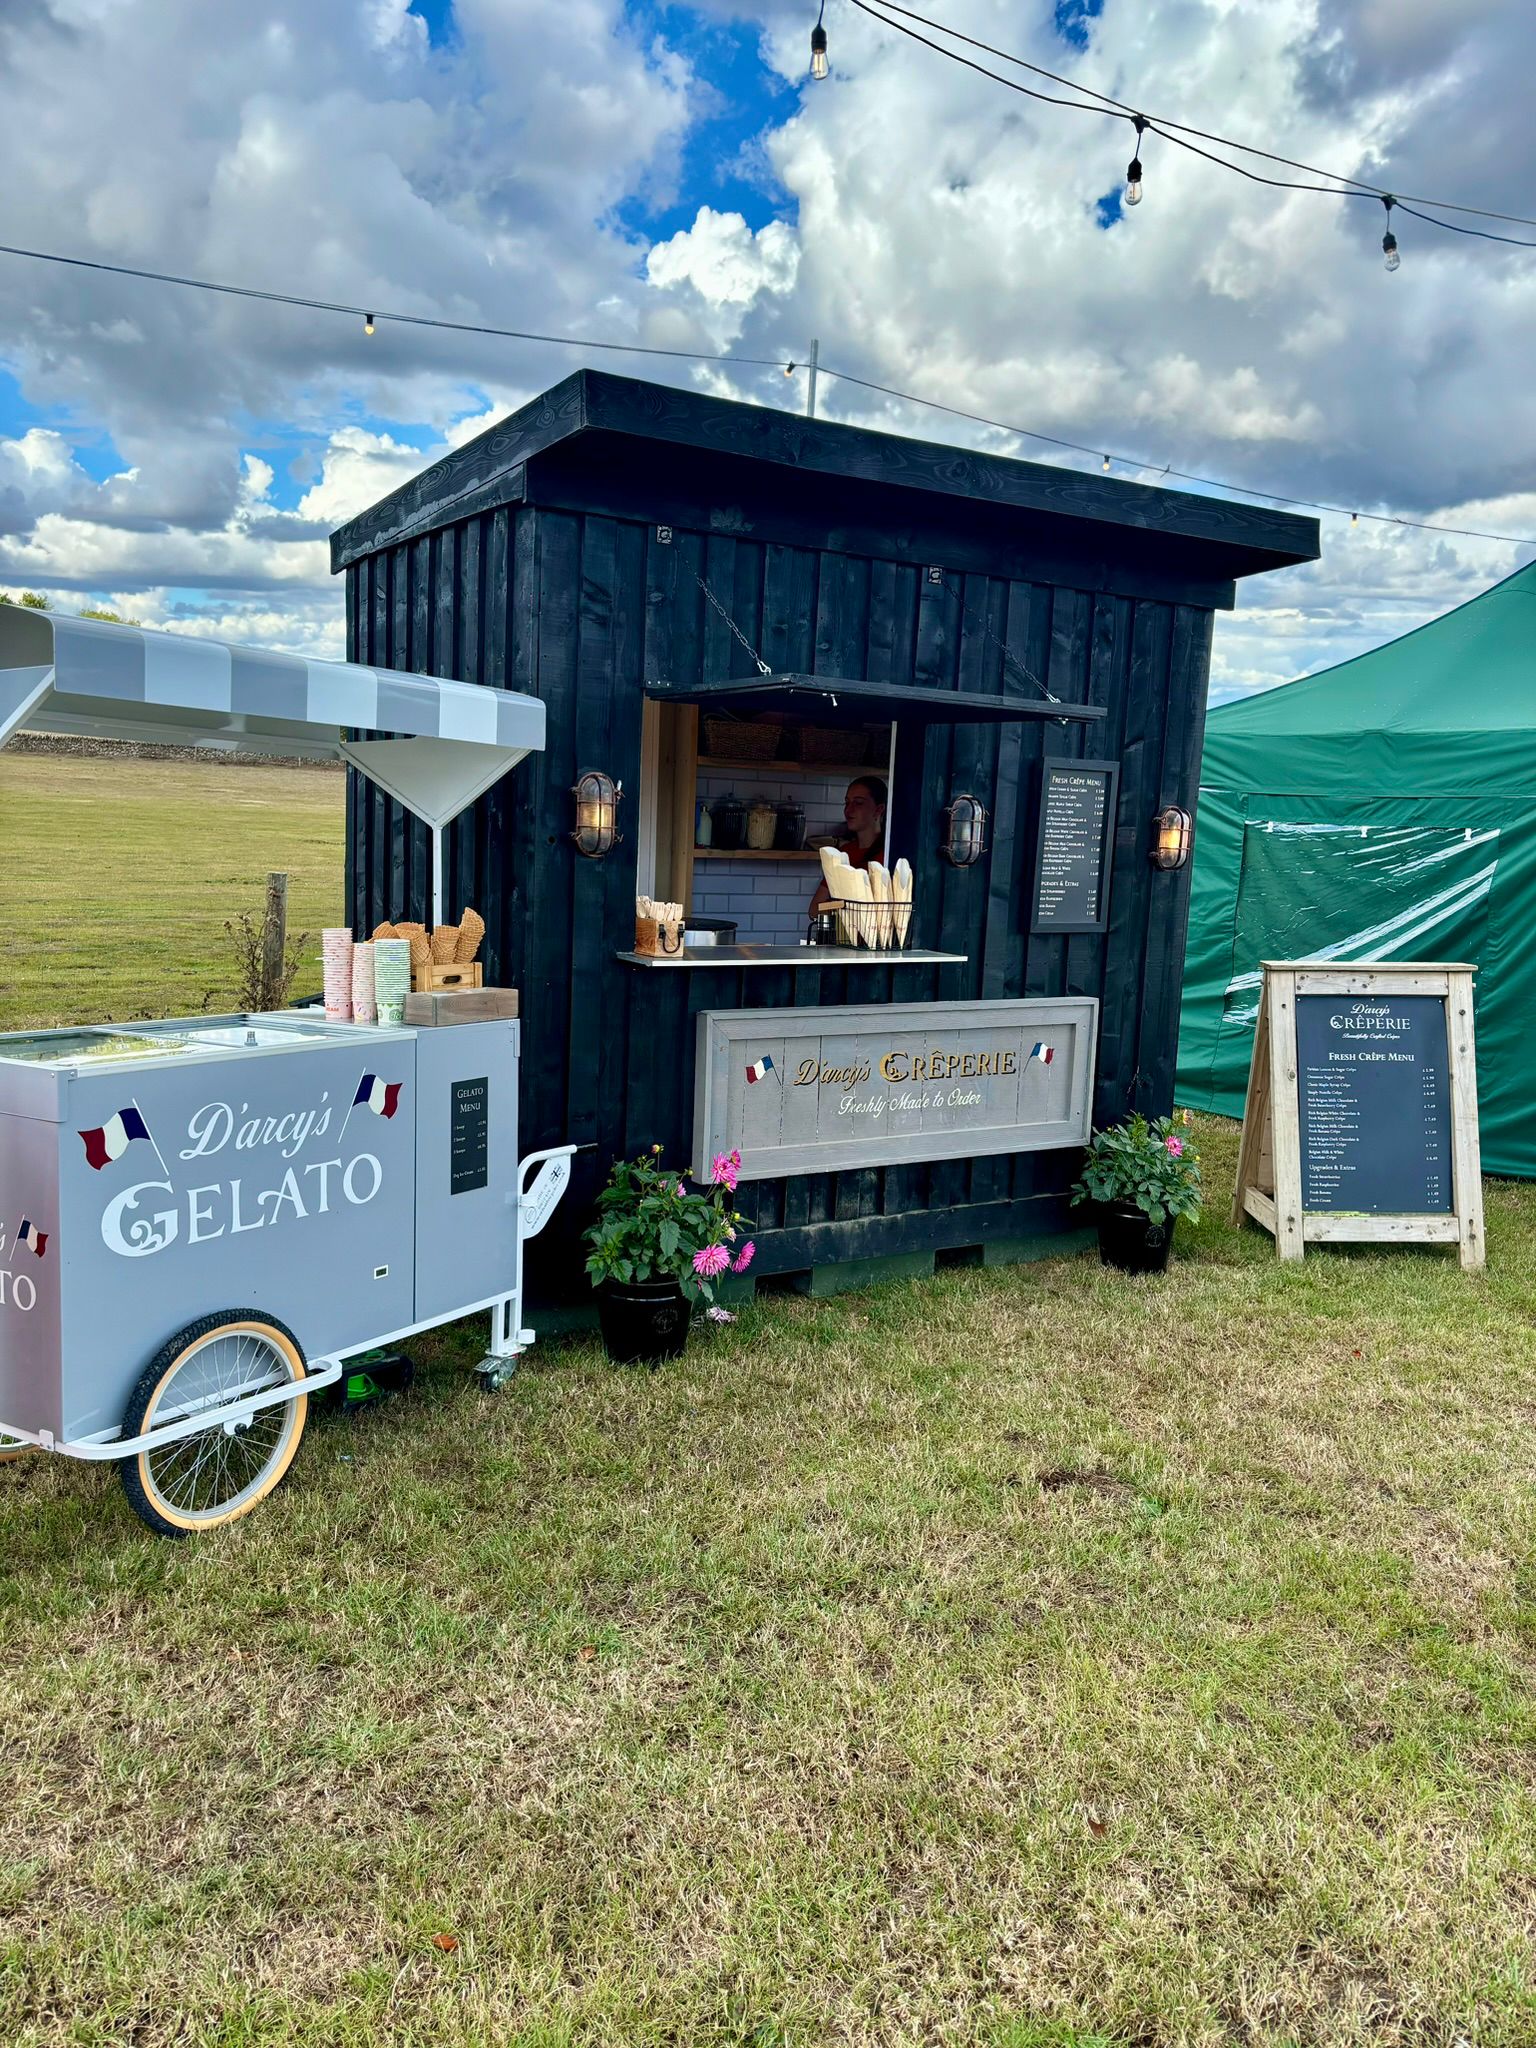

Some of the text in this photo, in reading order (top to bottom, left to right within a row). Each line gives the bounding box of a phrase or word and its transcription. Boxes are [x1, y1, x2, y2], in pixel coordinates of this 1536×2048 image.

[1330, 1014, 1411, 1030] CRÊPERIE
[1329, 1051, 1415, 1061] FRESH CRÊPE MENU
[793, 1050, 1017, 1091] D'arcy's CRÊPERIE
[457, 1087, 483, 1098] GELATO
[838, 1088, 981, 1118] Freshly Made to Order
[459, 1102, 480, 1113] MENU
[179, 1092, 332, 1160] D'arcy's
[101, 1154, 382, 1258] GELATO
